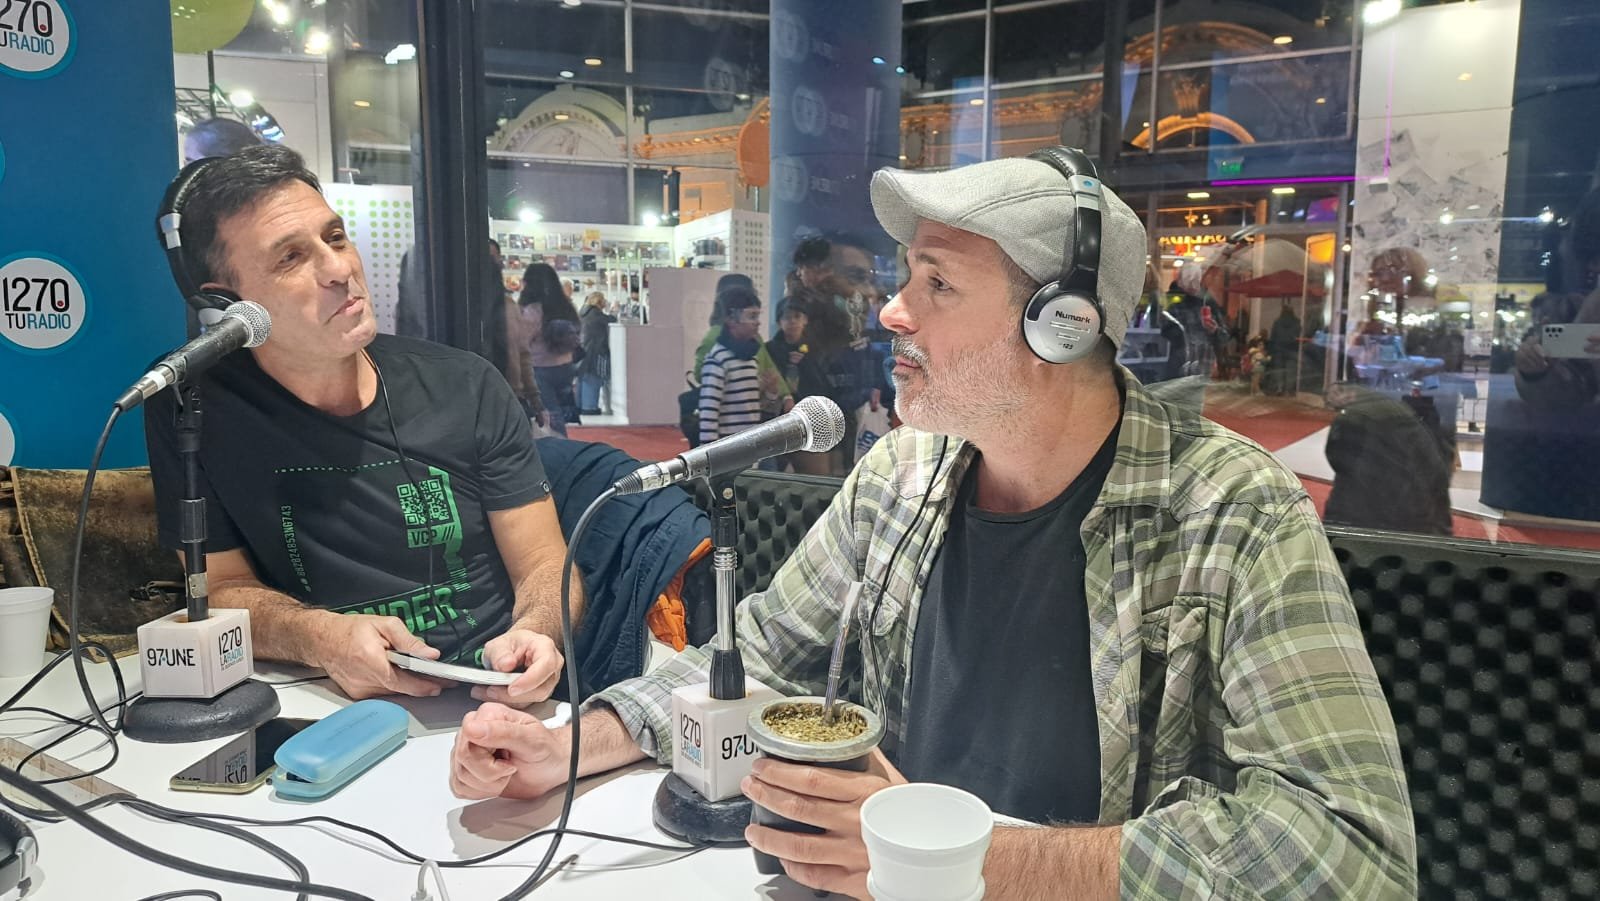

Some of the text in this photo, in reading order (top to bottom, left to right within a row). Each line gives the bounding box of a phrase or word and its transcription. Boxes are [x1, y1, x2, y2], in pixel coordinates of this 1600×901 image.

[0, 0, 53, 37] 270
[0, 31, 55, 55] URADIO
[3, 276, 70, 312] 1270
[1055, 310, 1091, 323] Numark
[218, 626, 242, 655] 1270
[680, 711, 702, 748] 1270
